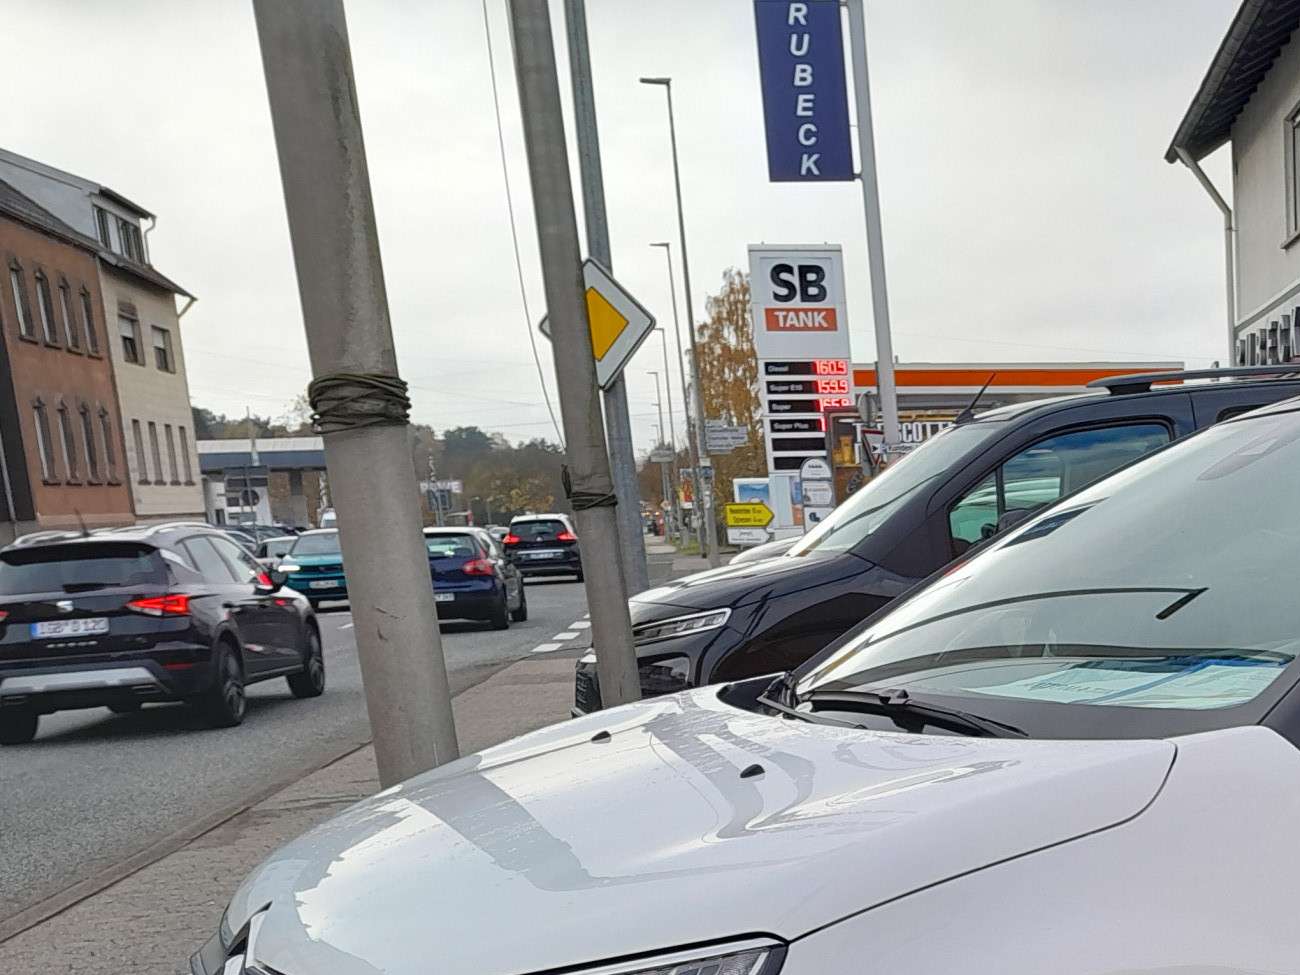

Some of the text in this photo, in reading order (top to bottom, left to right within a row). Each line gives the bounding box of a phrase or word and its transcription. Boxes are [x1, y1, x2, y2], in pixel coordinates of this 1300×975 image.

[788, 3, 820, 175] RUBECK
[770, 263, 828, 303] SB
[774, 311, 828, 328] TANK
